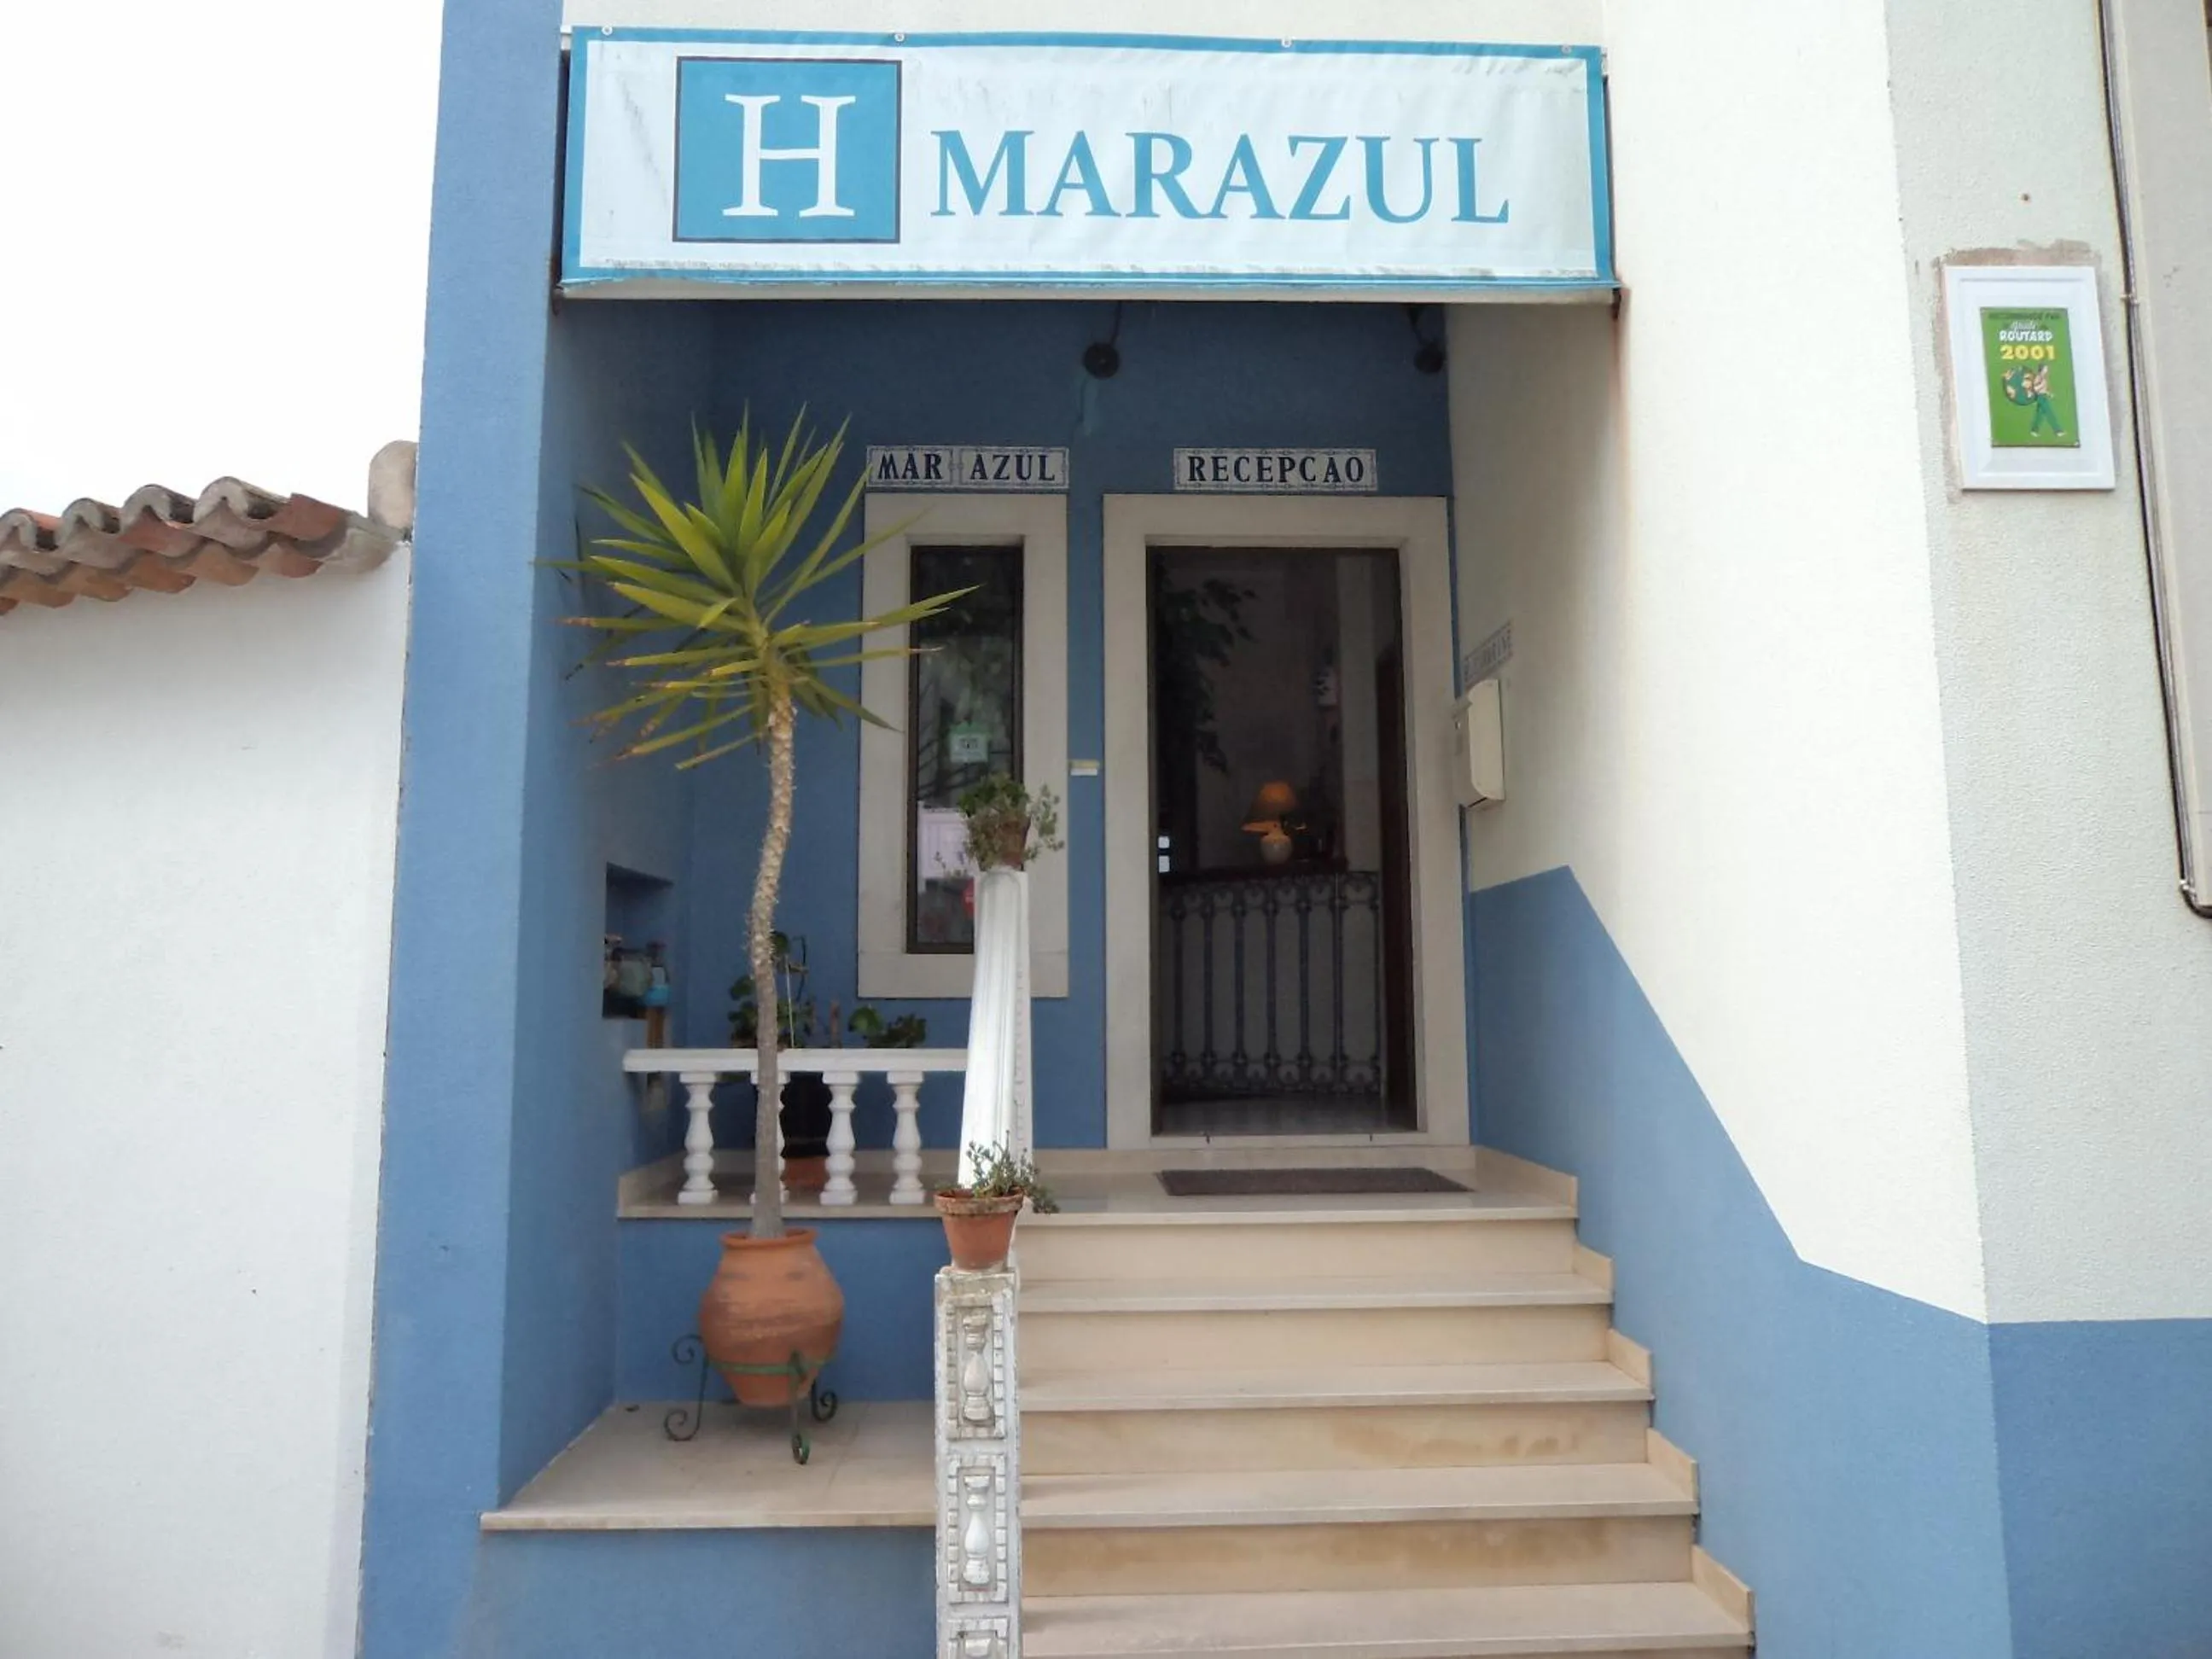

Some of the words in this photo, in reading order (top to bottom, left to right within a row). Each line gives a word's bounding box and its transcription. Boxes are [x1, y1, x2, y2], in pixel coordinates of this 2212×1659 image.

[723, 94, 856, 218] H
[930, 129, 1510, 224] MARAZUL
[1999, 329, 2053, 342] ROUTARD
[2000, 344, 2056, 360] 2001
[877, 452, 944, 480] MAR
[969, 453, 1056, 481] AZUL
[1187, 456, 1365, 483] RECEPCAO
